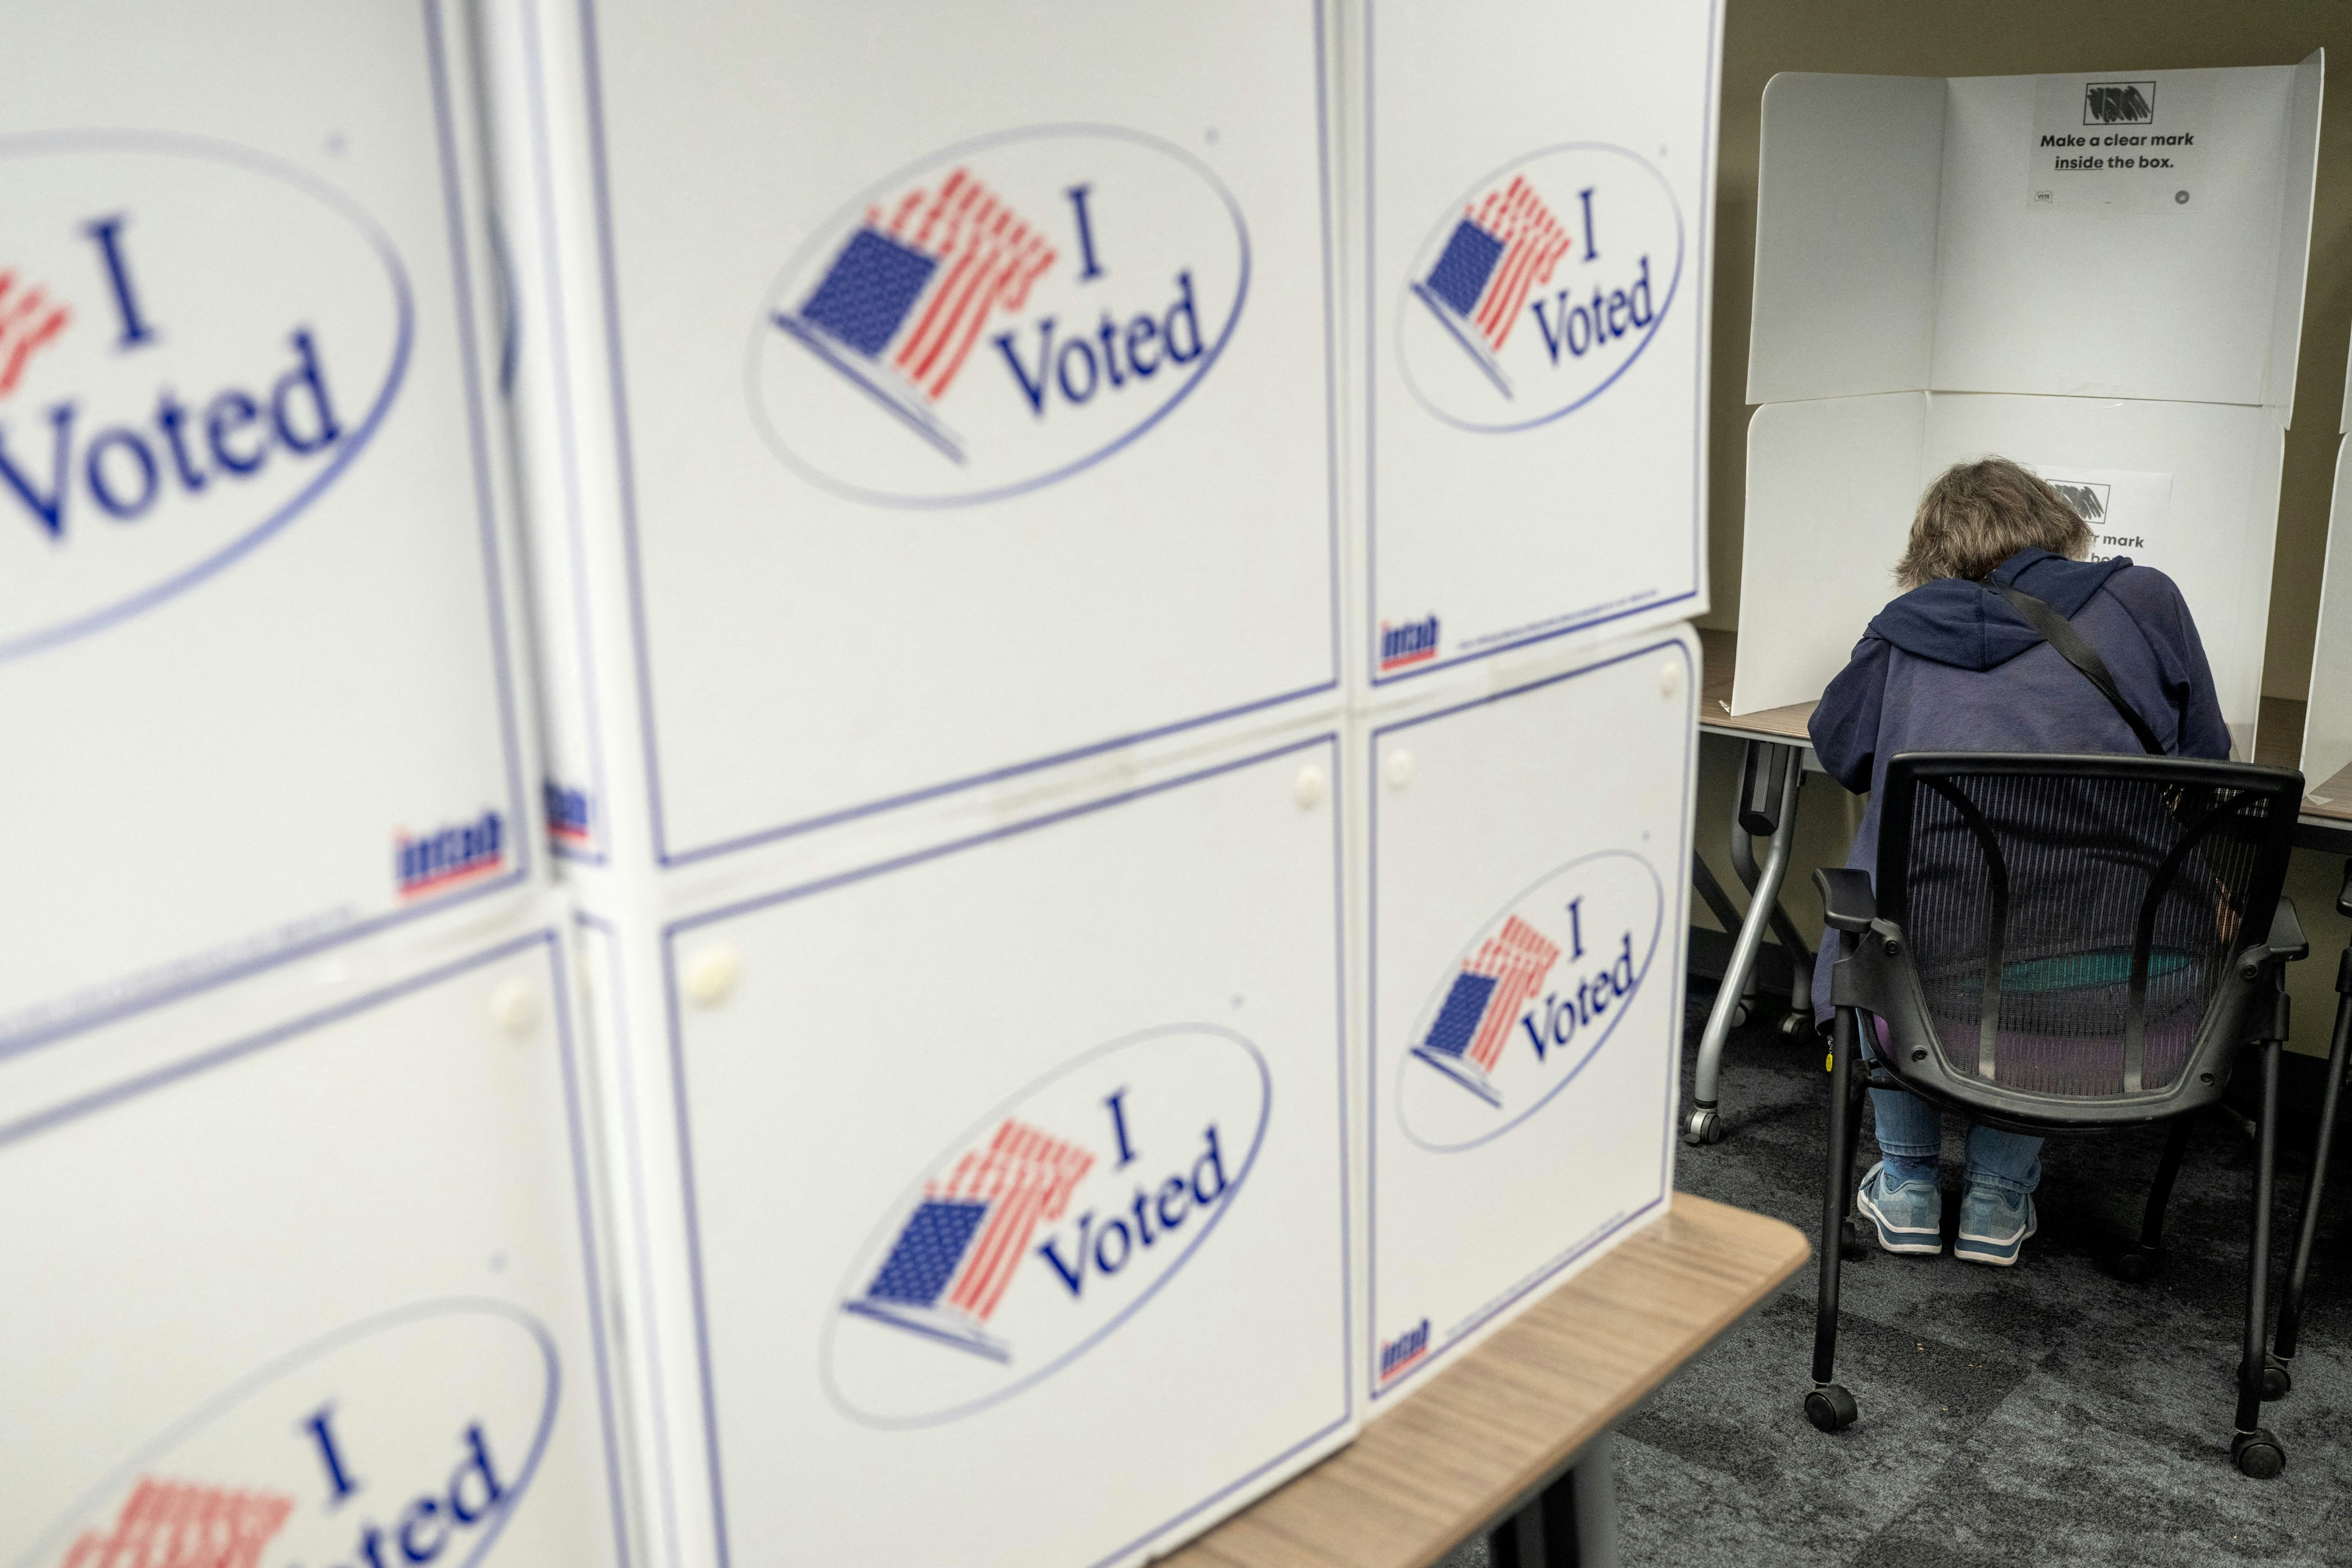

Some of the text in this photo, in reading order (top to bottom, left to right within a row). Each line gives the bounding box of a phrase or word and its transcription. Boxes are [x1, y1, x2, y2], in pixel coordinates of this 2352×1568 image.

[2040, 133, 2194, 147] Make a clear mark
[2055, 155, 2174, 169] inside the box.
[1065, 185, 1104, 282] I
[1578, 187, 1599, 262] I
[81, 216, 157, 349] I
[1531, 254, 1654, 367] Voted
[990, 266, 1203, 418] Voted
[0, 322, 343, 540] Voted
[2103, 535, 2144, 548] mark
[1567, 896, 1585, 962] I
[1521, 931, 1635, 1062] Voted
[1102, 1087, 1137, 1169] I
[1035, 1120, 1227, 1299] Voted
[284, 1420, 502, 1568] ted
[299, 1399, 363, 1509] I
